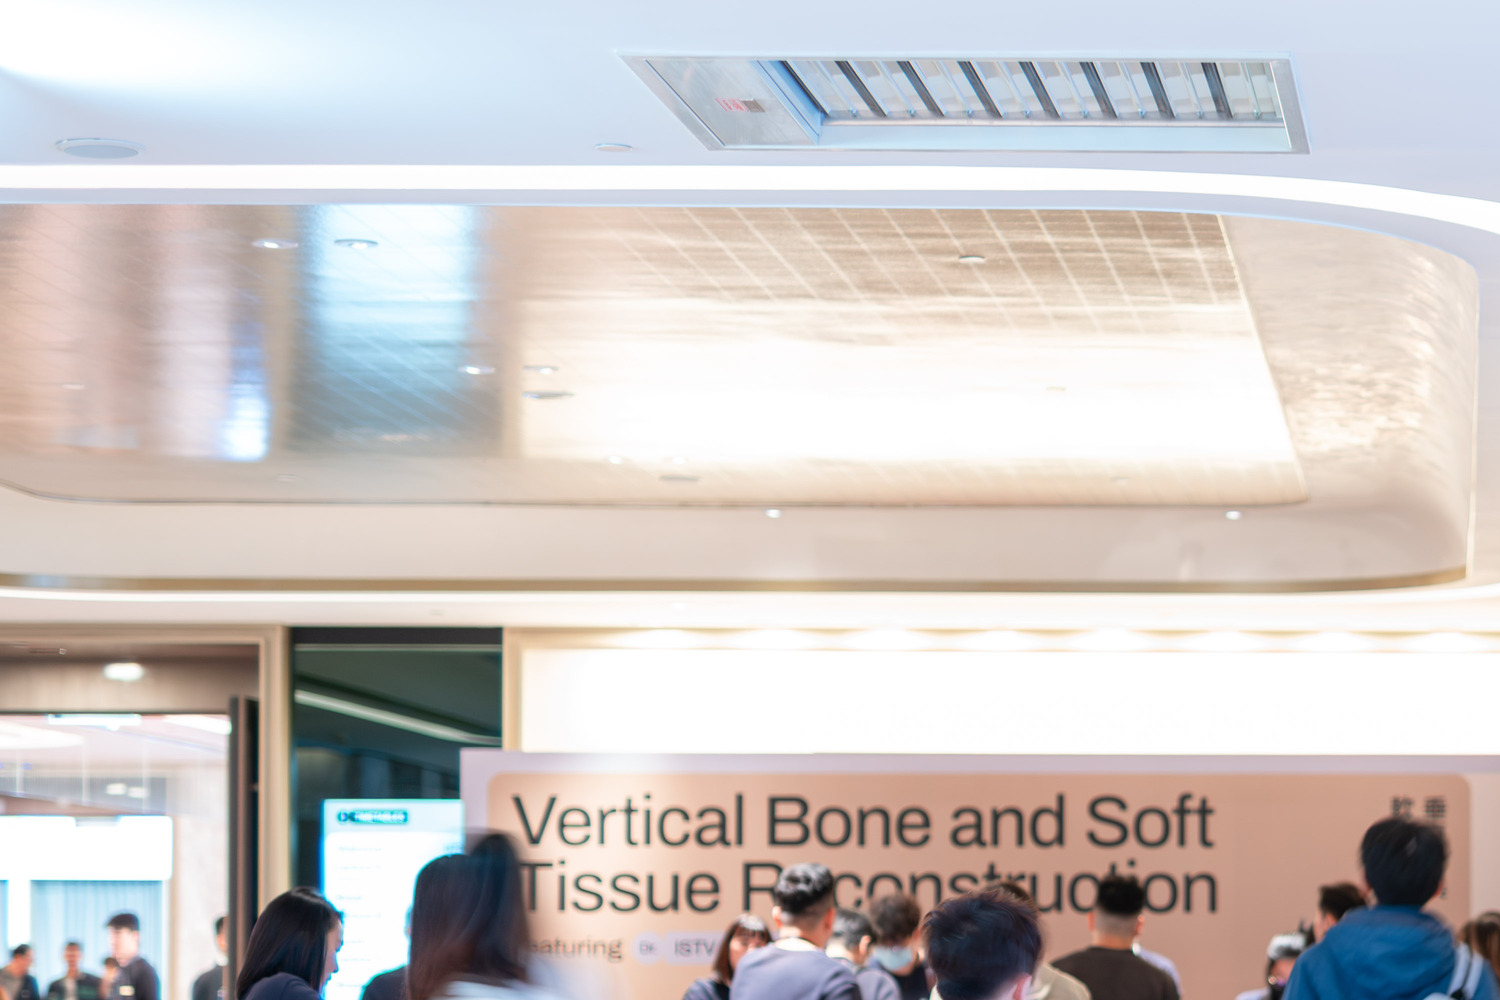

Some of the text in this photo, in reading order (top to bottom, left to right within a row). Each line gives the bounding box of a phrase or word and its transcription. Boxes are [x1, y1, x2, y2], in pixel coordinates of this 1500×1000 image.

[511, 792, 1215, 850] Vertical Bone and Soft
[520, 859, 721, 912] Tissue
[674, 937, 716, 957] ISTV
